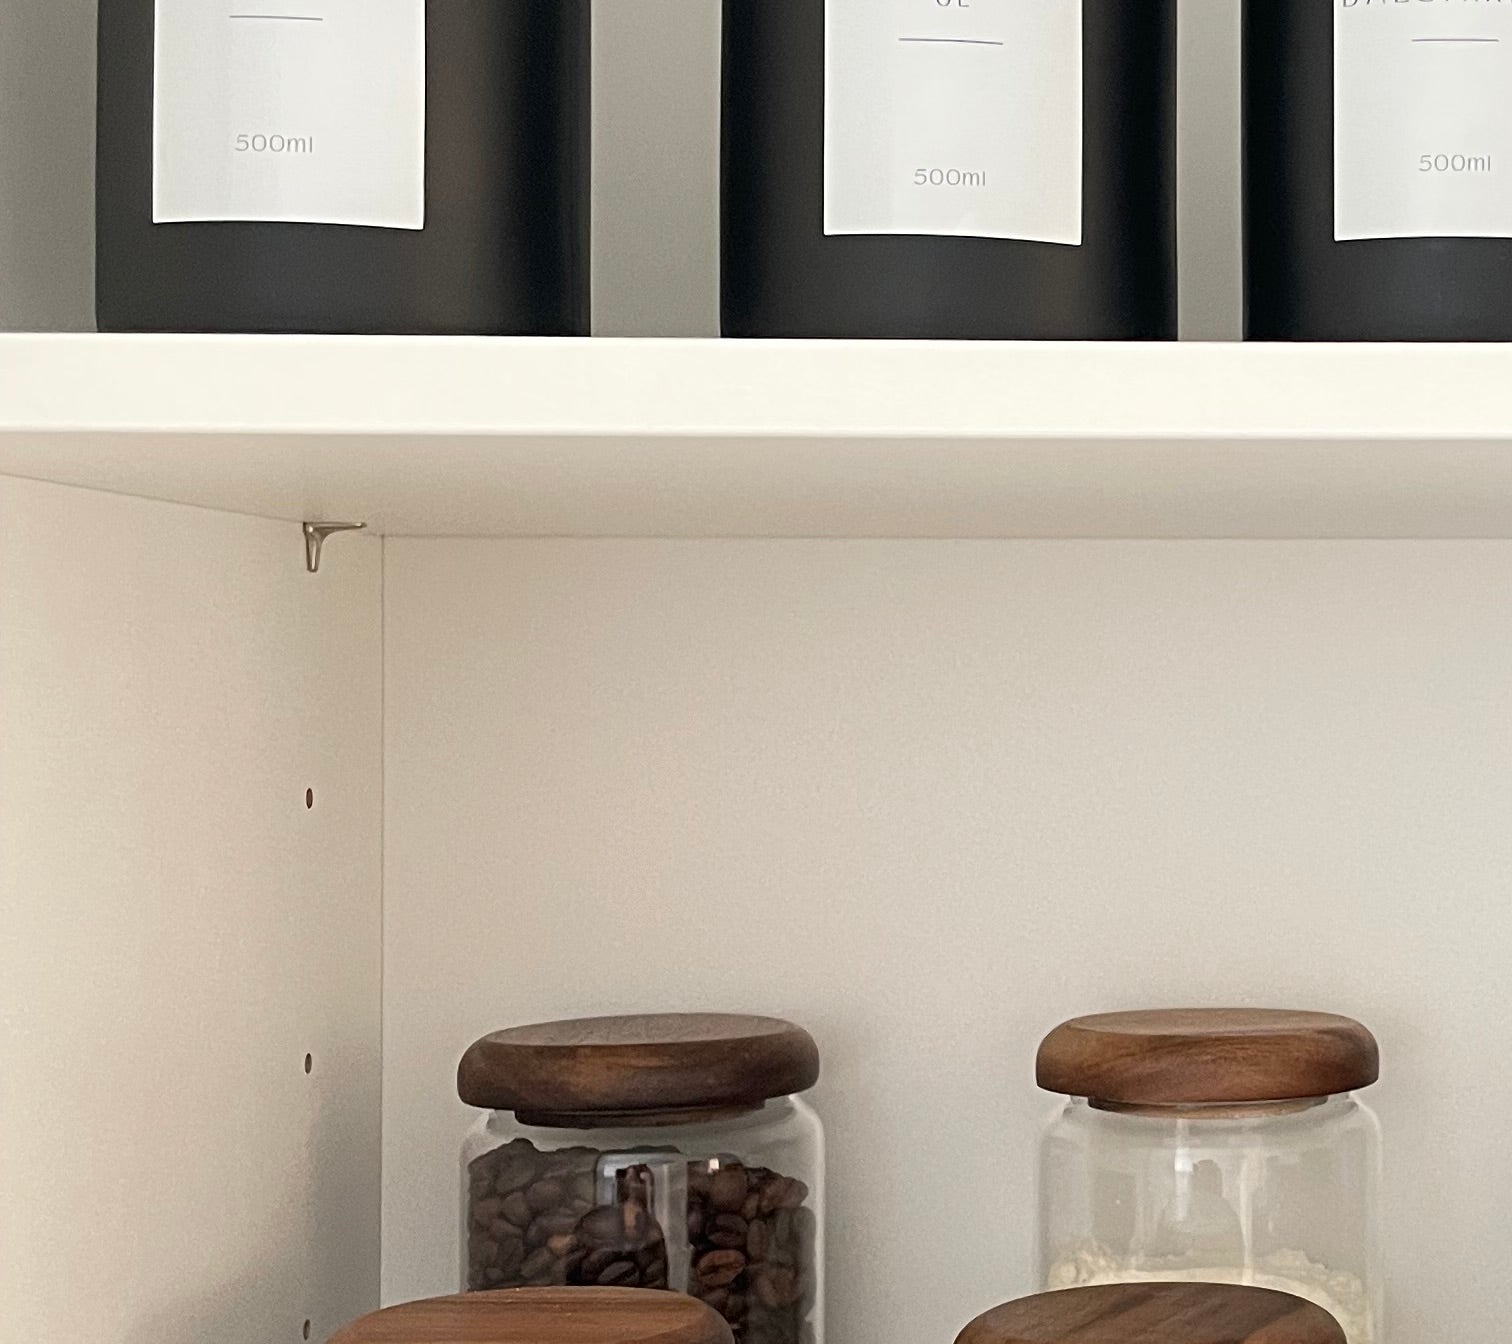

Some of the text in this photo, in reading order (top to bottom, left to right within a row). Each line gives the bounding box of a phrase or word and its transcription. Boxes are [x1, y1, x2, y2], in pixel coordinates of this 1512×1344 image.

[233, 131, 315, 155] 500ml
[1419, 154, 1490, 172] 500ml
[914, 168, 985, 187] 500ml
